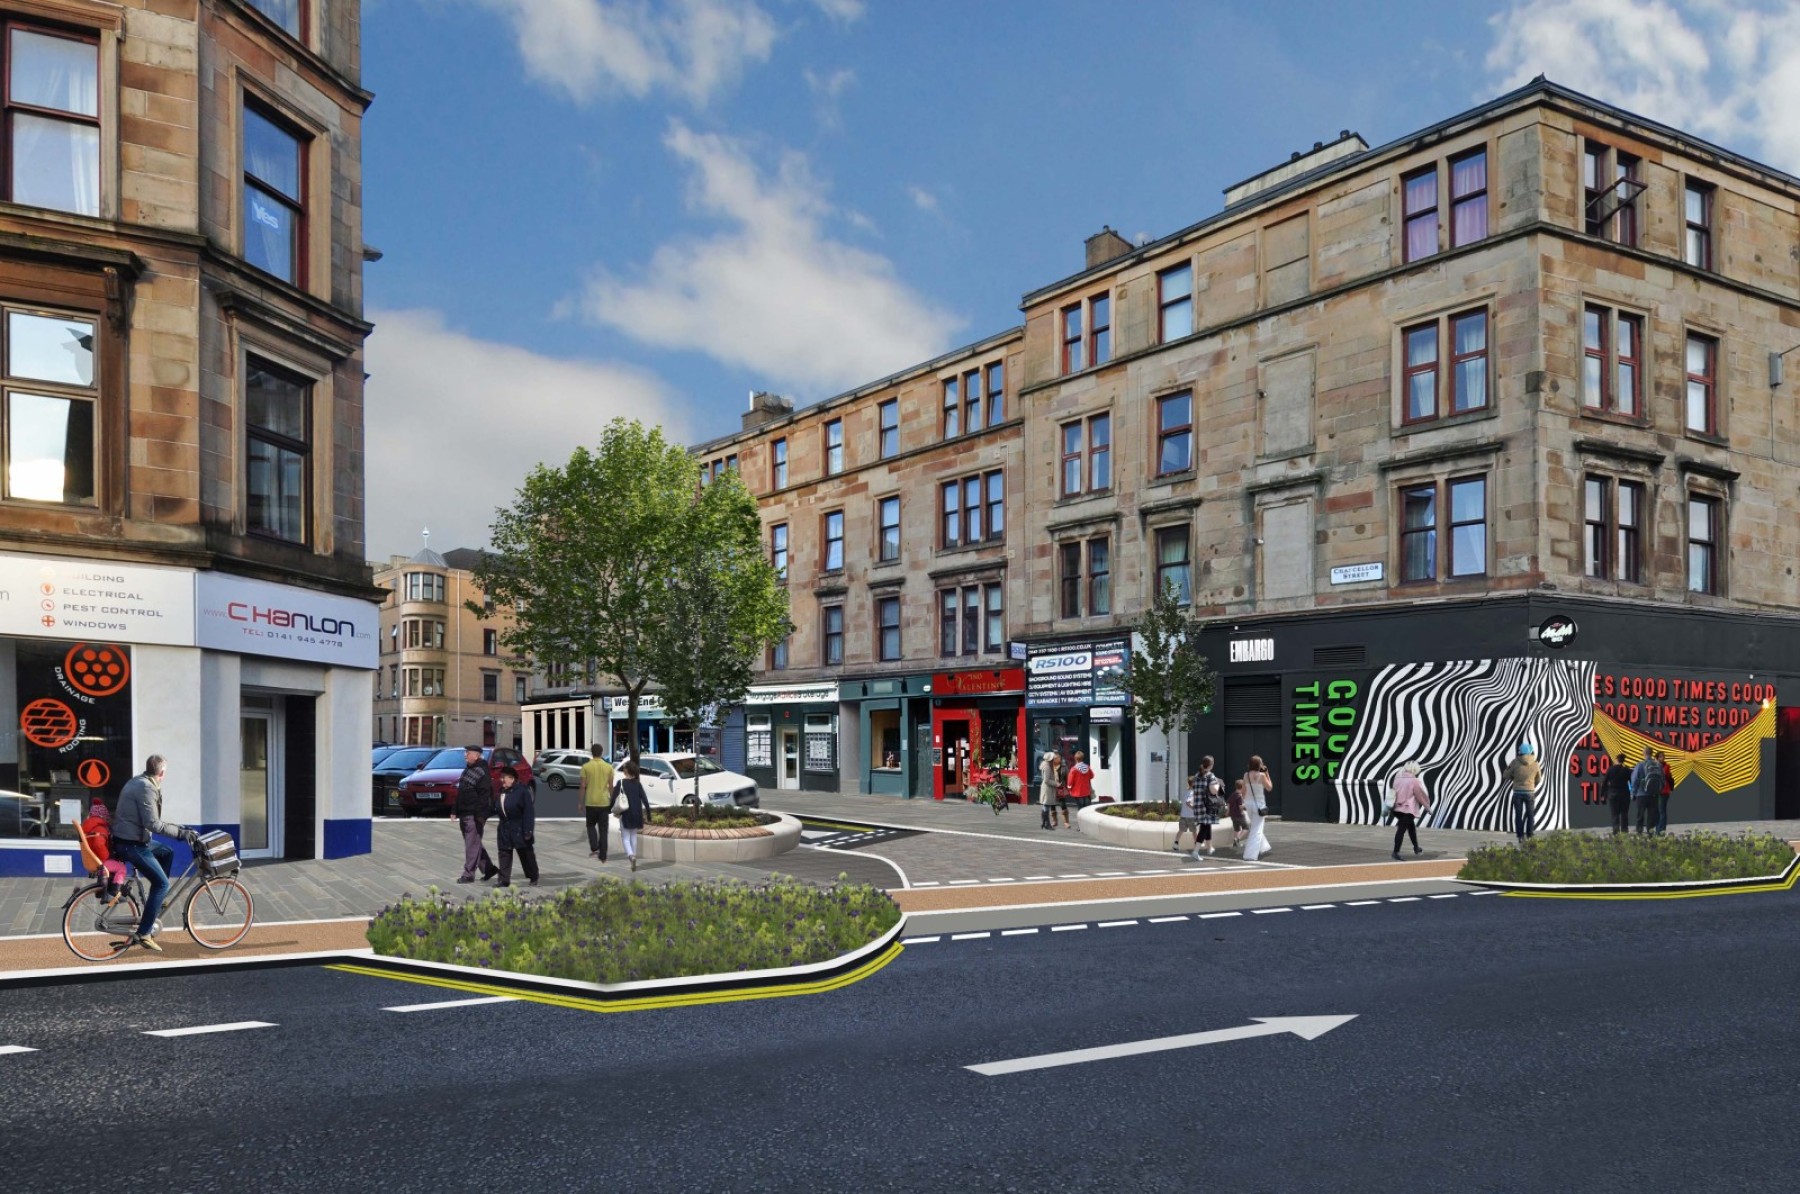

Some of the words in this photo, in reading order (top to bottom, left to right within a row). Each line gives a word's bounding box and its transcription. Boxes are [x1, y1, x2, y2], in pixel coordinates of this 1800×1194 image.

[1333, 564, 1379, 574] CHANCELLOR
[1342, 571, 1370, 580] STREET
[71, 572, 125, 583] UILDING
[62, 587, 144, 600] ELECTRICAL
[62, 603, 97, 613] PEST
[101, 605, 164, 617] CONTROL
[62, 619, 127, 630] WINDOWS
[267, 631, 293, 641] 0141
[1230, 638, 1274, 663] EMBARGO
[1035, 655, 1088, 669] RS100
[54, 666, 95, 705] DRAINAGE
[1620, 676, 1667, 698] GOOD
[1672, 679, 1727, 701] TIMES
[1731, 682, 1774, 703] GOOD
[1645, 704, 1700, 726] TIMES
[1706, 707, 1750, 727] GOOD
[1294, 680, 1320, 780] TIMES
